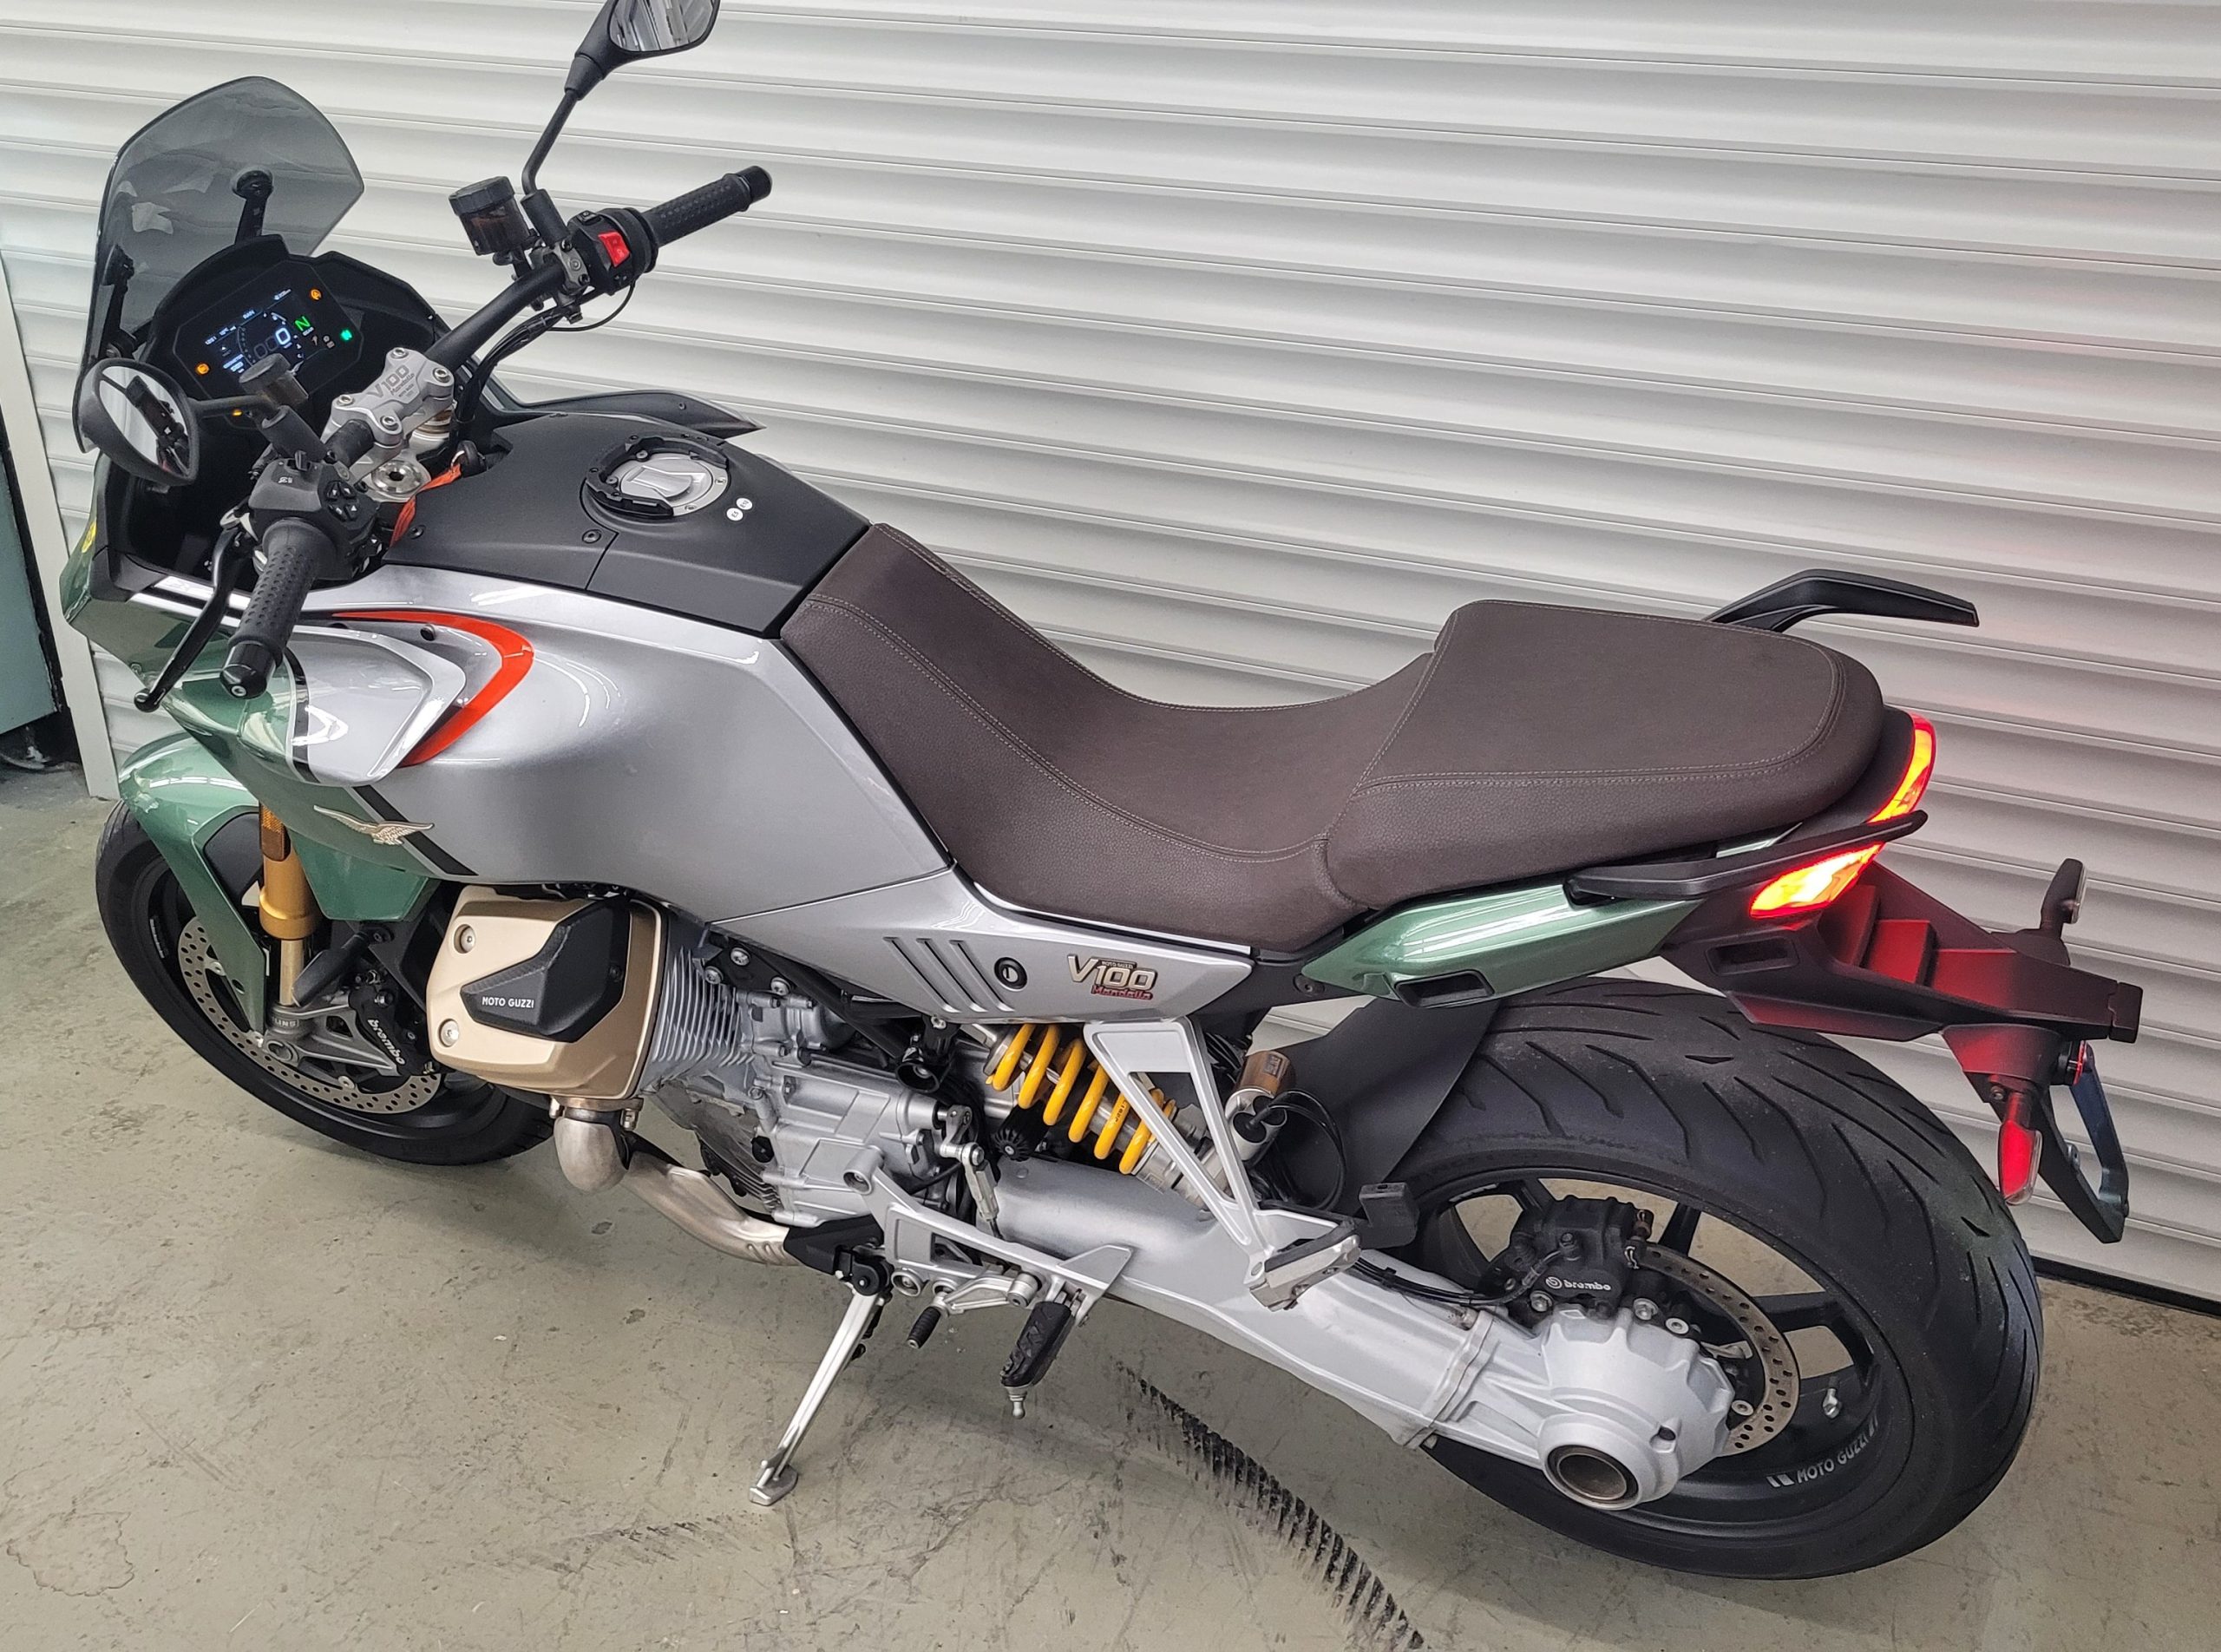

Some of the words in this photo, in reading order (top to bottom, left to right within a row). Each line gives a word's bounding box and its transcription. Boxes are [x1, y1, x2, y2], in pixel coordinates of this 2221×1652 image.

[295, 316, 311, 331] N
[365, 365, 409, 398] V100
[1067, 954, 1157, 991] V100
[482, 996, 506, 1006] MOTO
[508, 998, 534, 1008] GUZZI
[1091, 984, 1152, 1000] Mandello
[367, 1019, 406, 1065] brembo
[1563, 1279, 1612, 1291] brembo
[1797, 1458, 1835, 1484] MOTO
[1837, 1432, 1870, 1465] GUZZI
